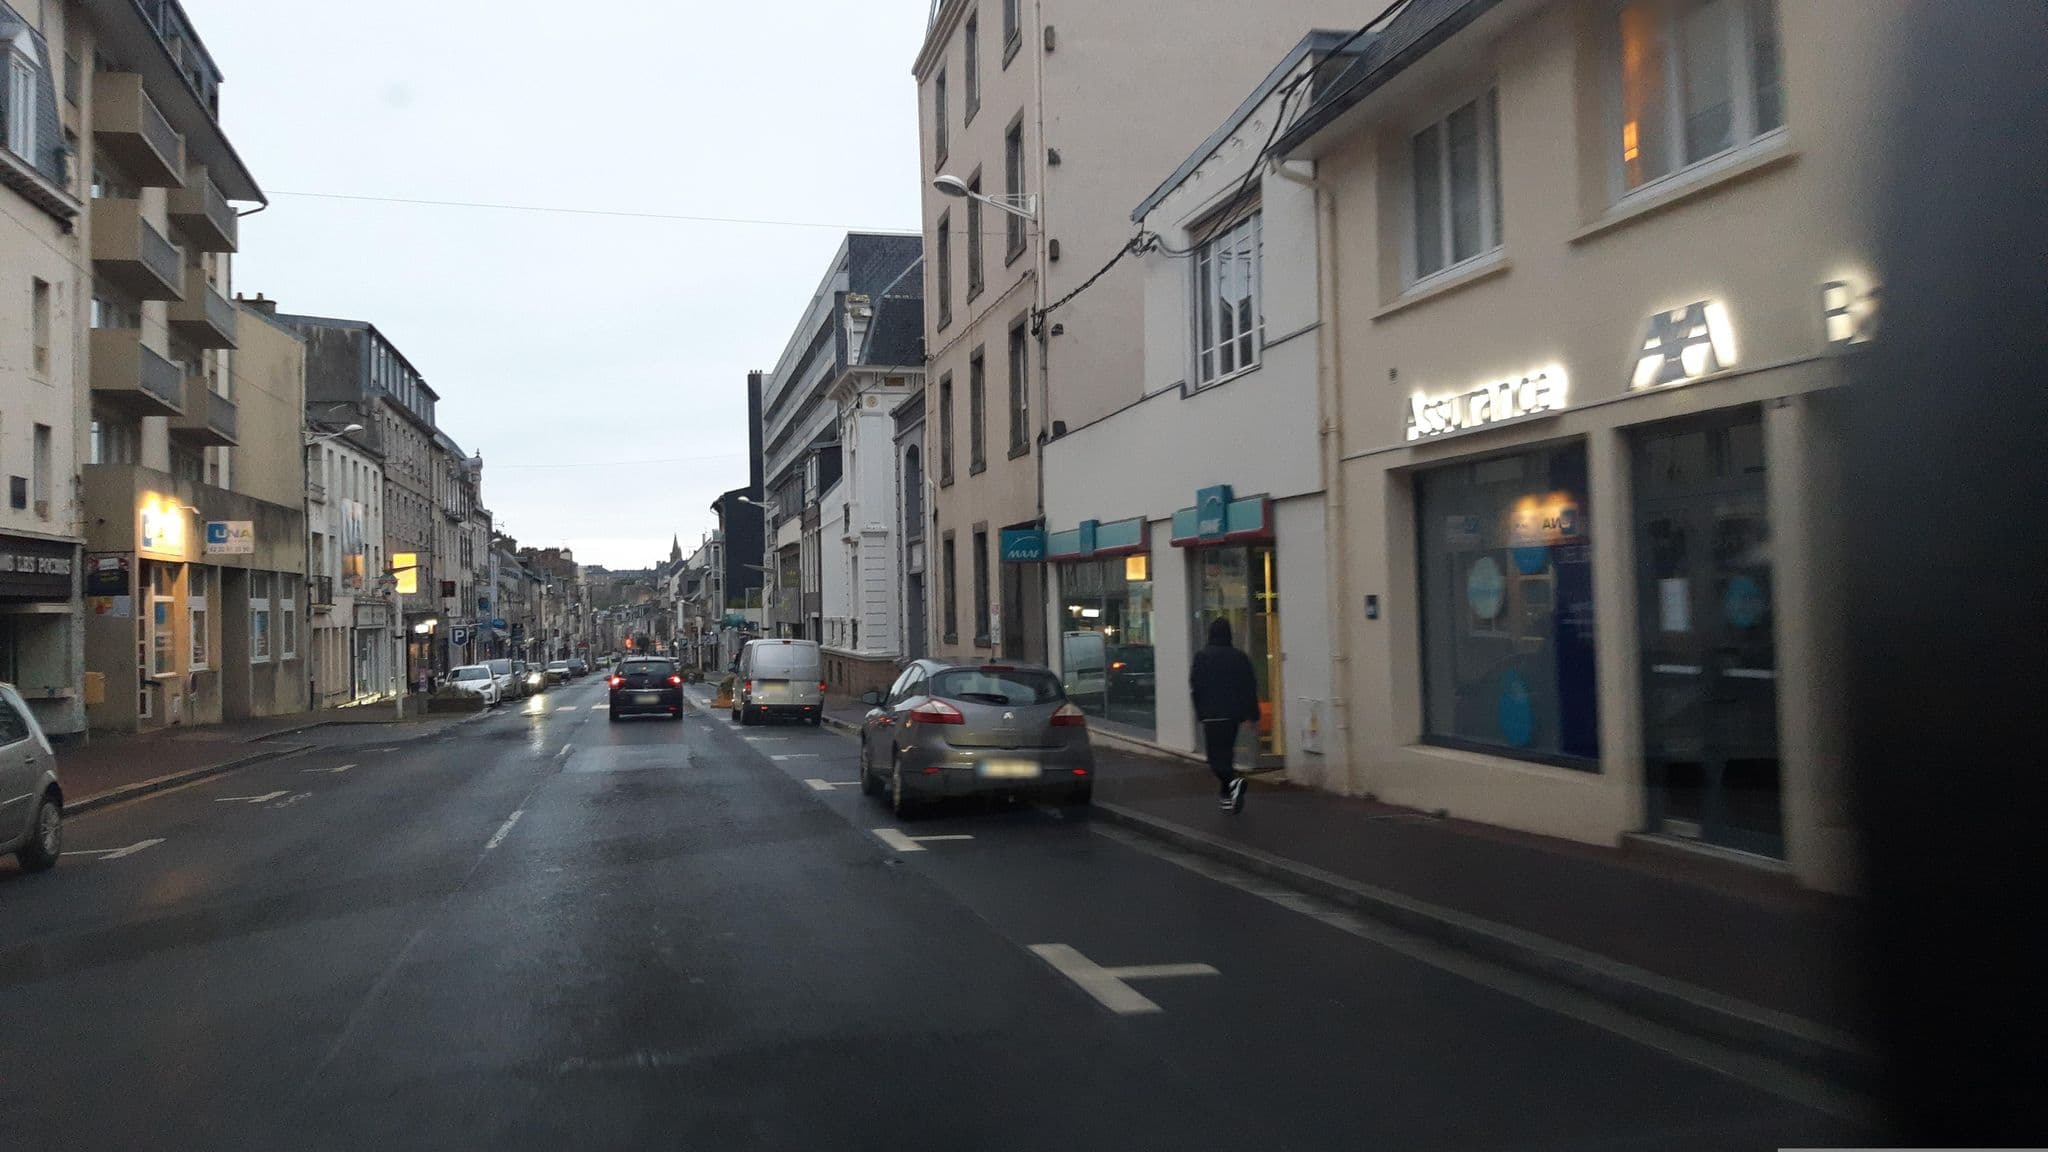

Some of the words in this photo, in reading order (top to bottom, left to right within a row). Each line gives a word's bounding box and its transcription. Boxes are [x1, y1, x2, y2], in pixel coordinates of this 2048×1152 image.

[215, 528, 251, 539] UNA
[1008, 549, 1040, 559] MAAF
[455, 629, 465, 642] P
